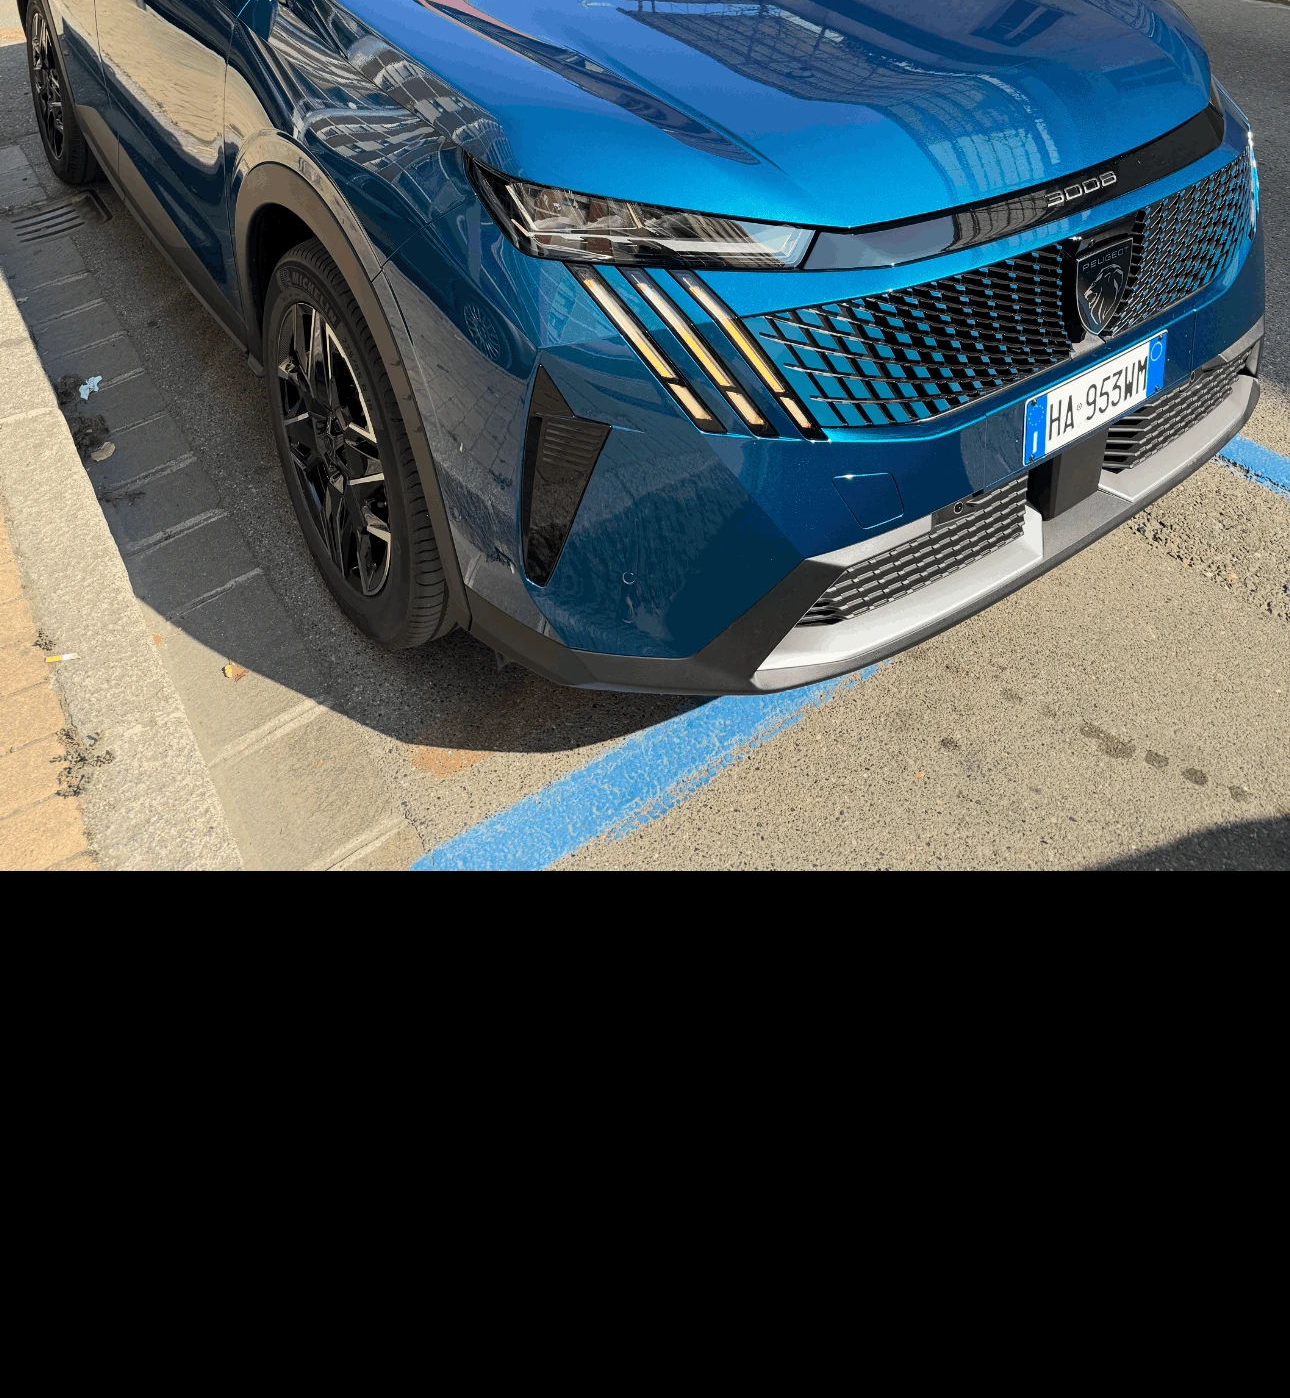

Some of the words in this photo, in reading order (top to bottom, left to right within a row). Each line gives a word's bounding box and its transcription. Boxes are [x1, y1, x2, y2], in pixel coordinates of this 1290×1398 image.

[1043, 170, 1117, 208] 3008
[1082, 245, 1130, 272] PEUGEOT
[291, 271, 337, 325] MICHELIN
[1048, 394, 1075, 441] HA
[1085, 355, 1148, 421] 953WM
[1032, 430, 1039, 455] I
